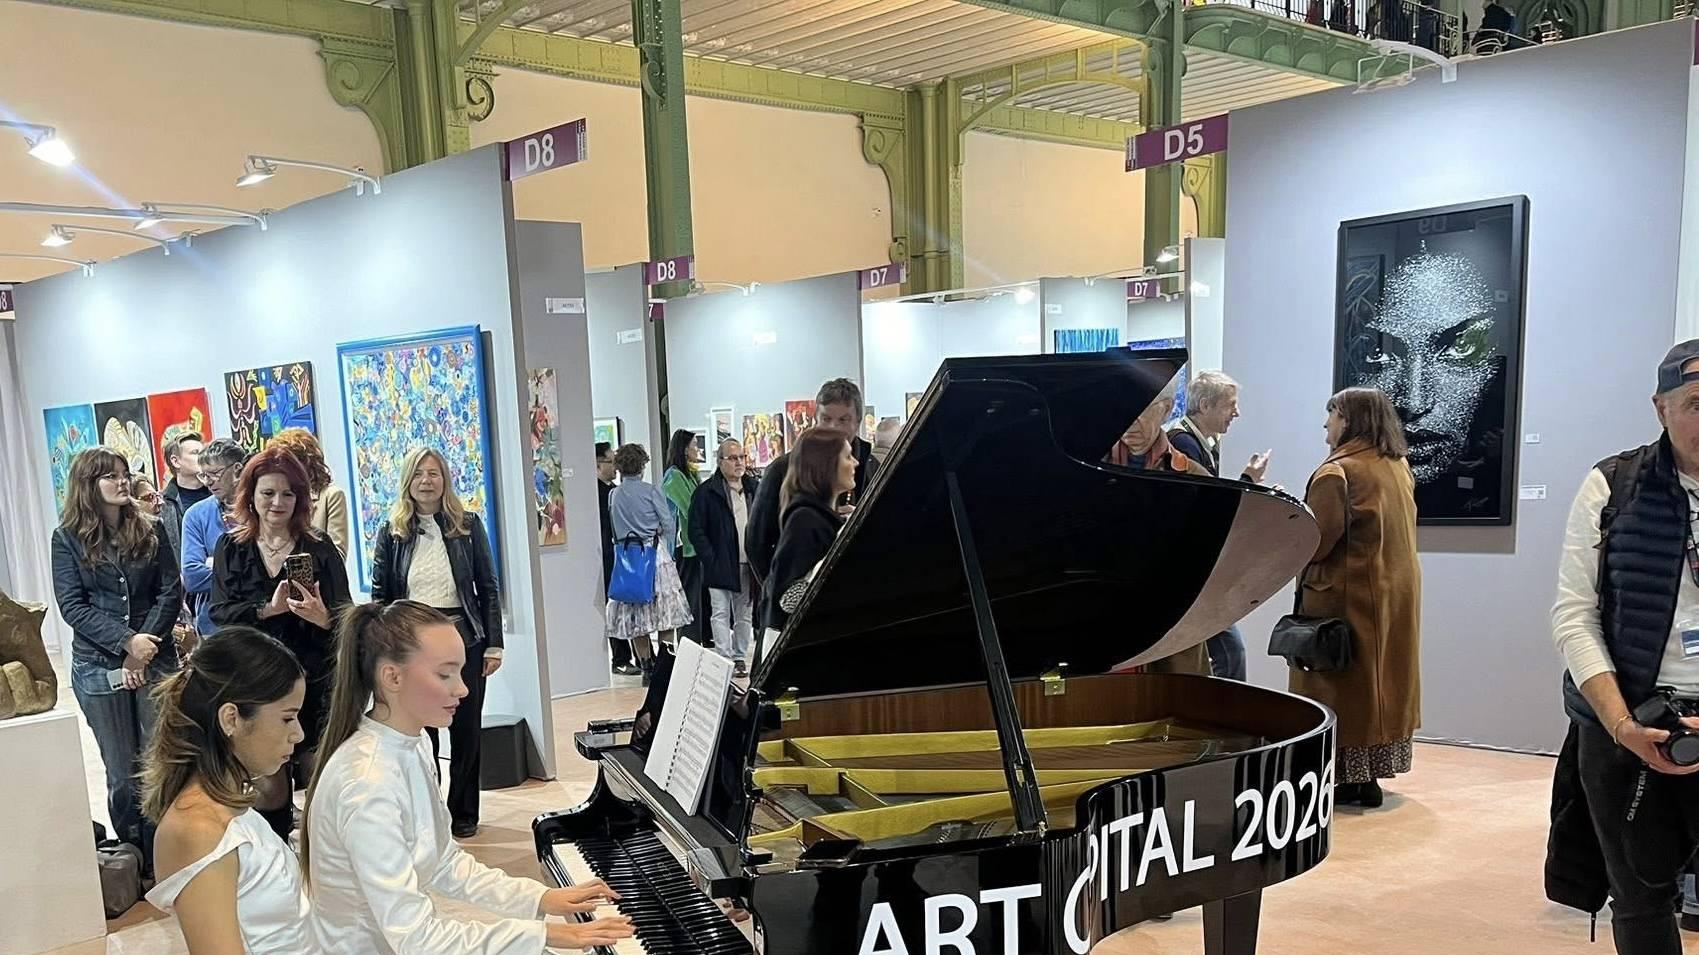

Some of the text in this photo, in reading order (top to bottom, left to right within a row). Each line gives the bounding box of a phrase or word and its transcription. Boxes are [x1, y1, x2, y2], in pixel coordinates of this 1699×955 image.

[524, 133, 555, 172] D8
[1164, 124, 1204, 161] D5
[657, 260, 676, 282] D8
[870, 267, 888, 287] D7
[1134, 282, 1148, 297] D7
[0, 291, 8, 311] 8
[648, 303, 654, 318] 7
[858, 759, 1335, 955] ART CITAL 2026
